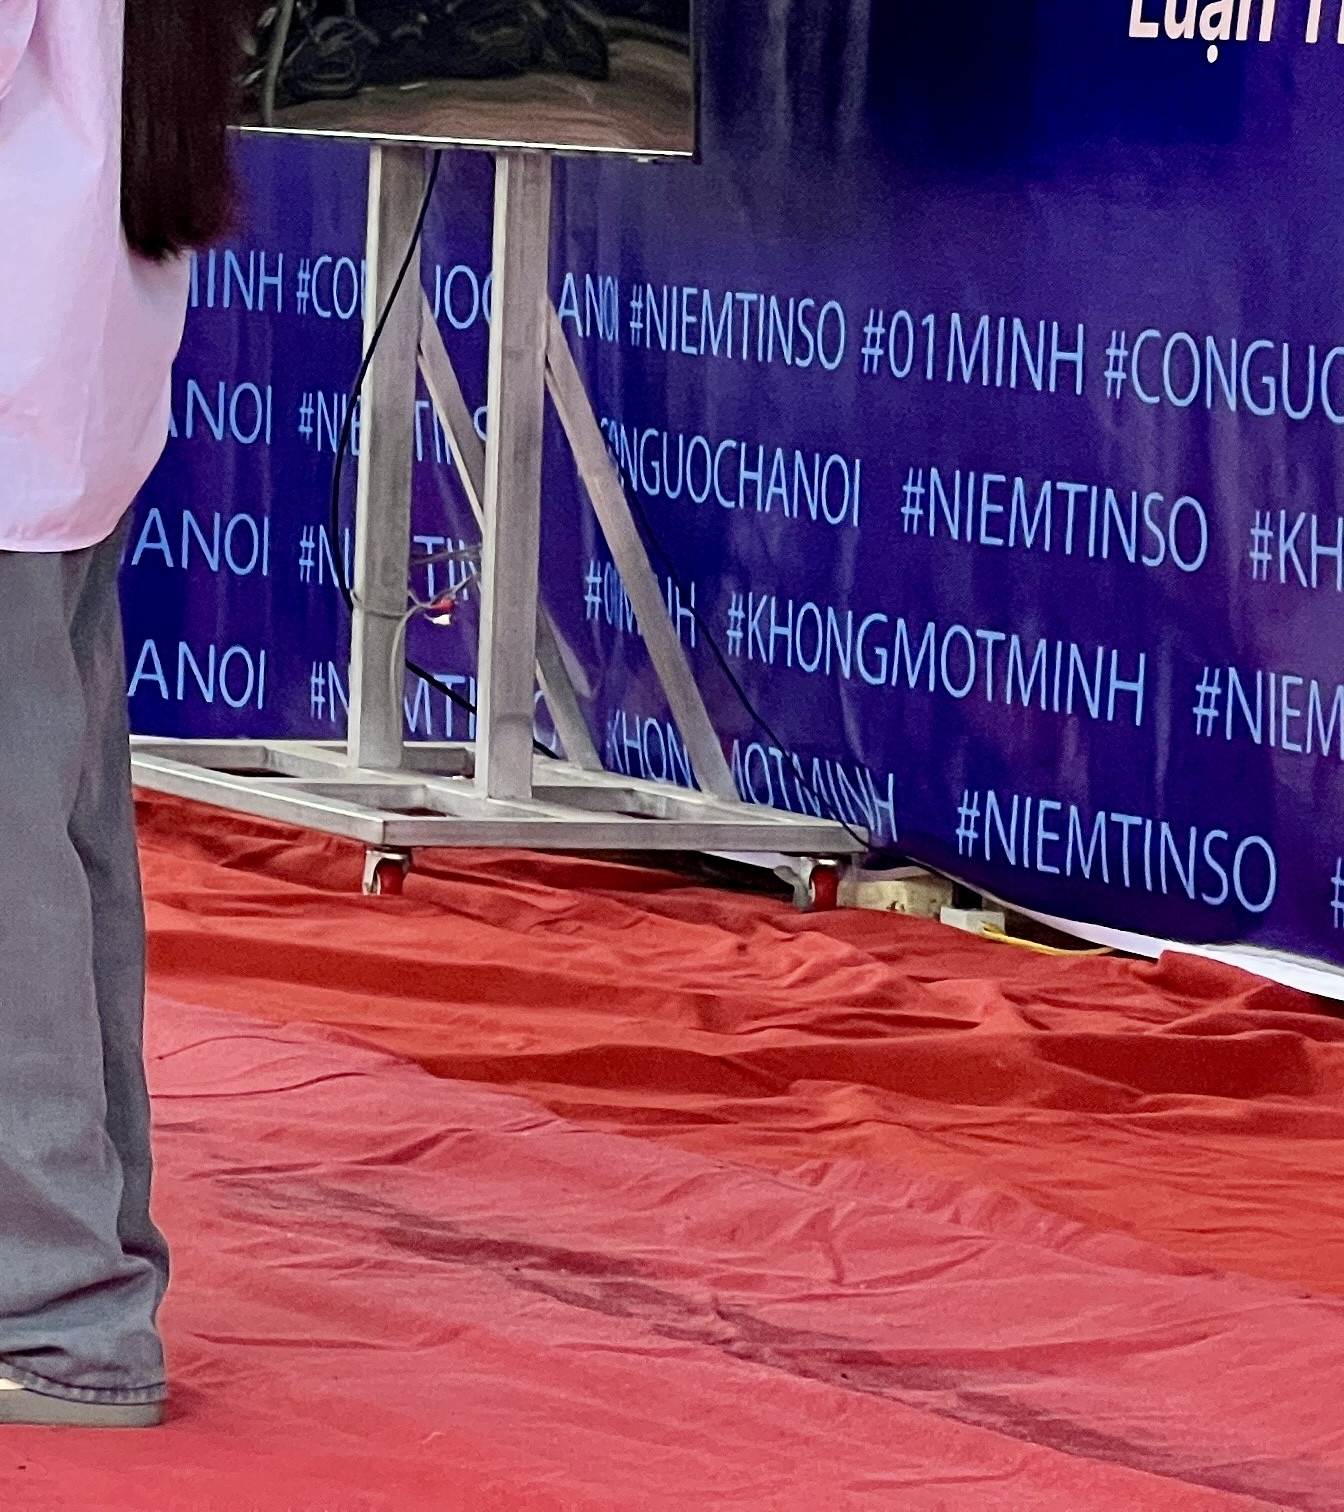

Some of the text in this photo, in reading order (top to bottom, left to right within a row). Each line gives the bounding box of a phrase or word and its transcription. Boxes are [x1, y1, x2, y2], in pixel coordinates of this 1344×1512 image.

[630, 282, 847, 371] #NIEMTINSO
[861, 307, 1085, 396] #01MINH
[901, 466, 1207, 572] #NIEMTINSO
[1249, 509, 1344, 592] #KH
[726, 591, 1147, 727] #KHONGMOTMINH
[1192, 666, 1344, 761] #NIEM
[956, 789, 1277, 913] #NIEMTINSO
